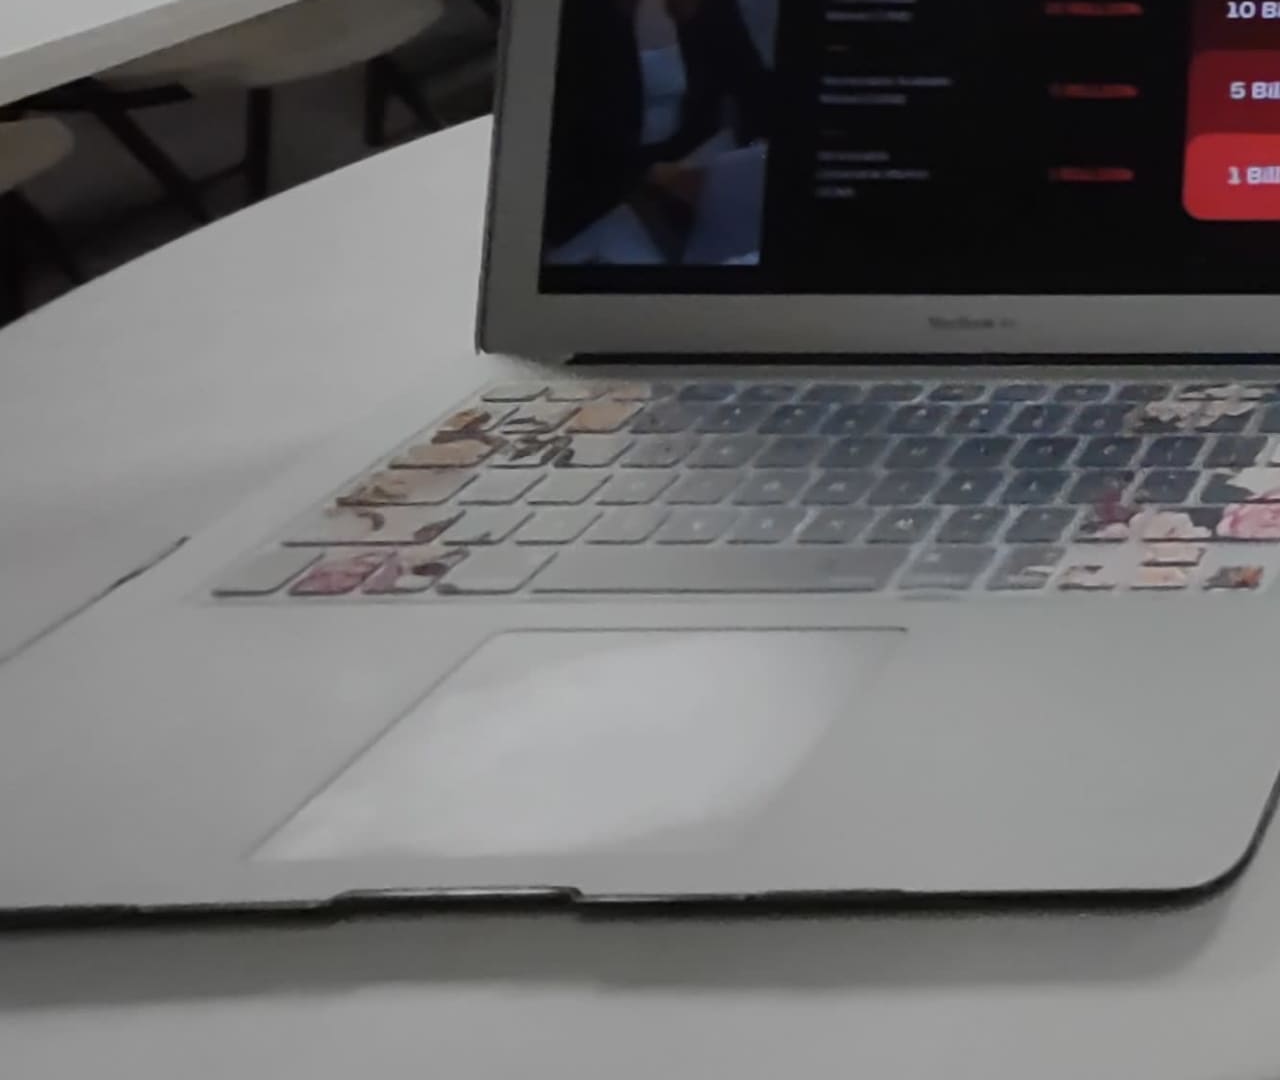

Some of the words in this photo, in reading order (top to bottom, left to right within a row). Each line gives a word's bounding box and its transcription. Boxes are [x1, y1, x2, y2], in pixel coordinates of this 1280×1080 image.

[1226, 1, 1256, 18] 10
[1229, 82, 1246, 99] 5
[1227, 166, 1241, 185] 1
